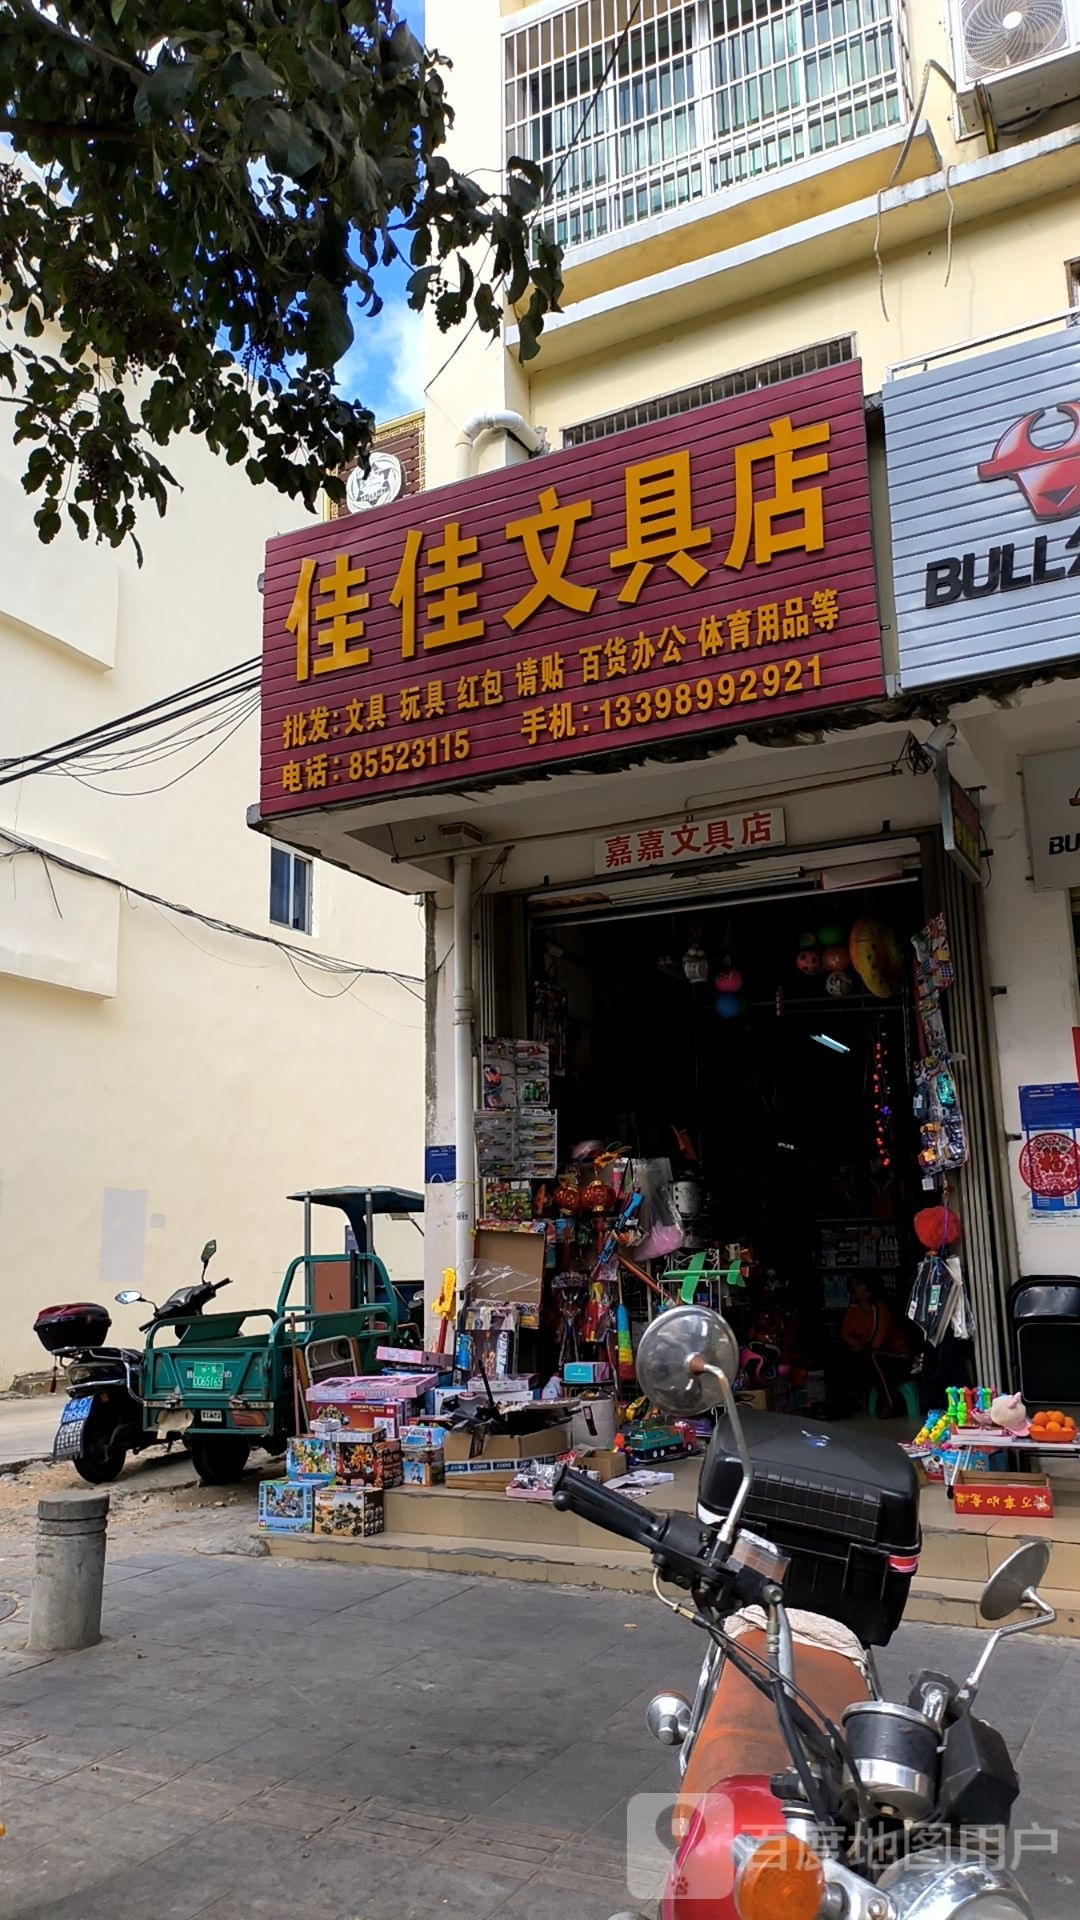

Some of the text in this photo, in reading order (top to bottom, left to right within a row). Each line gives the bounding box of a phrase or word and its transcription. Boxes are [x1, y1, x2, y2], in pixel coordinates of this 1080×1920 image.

[285, 415, 831, 681] 佳佳文具店
[400, 681, 445, 721] 玩具
[456, 669, 503, 710] 红包
[516, 652, 564, 696] 请贴
[579, 625, 686, 683] 百货办公
[697, 588, 839, 657] 体育用品等
[604, 812, 772, 868] 嘉嘉文具店
